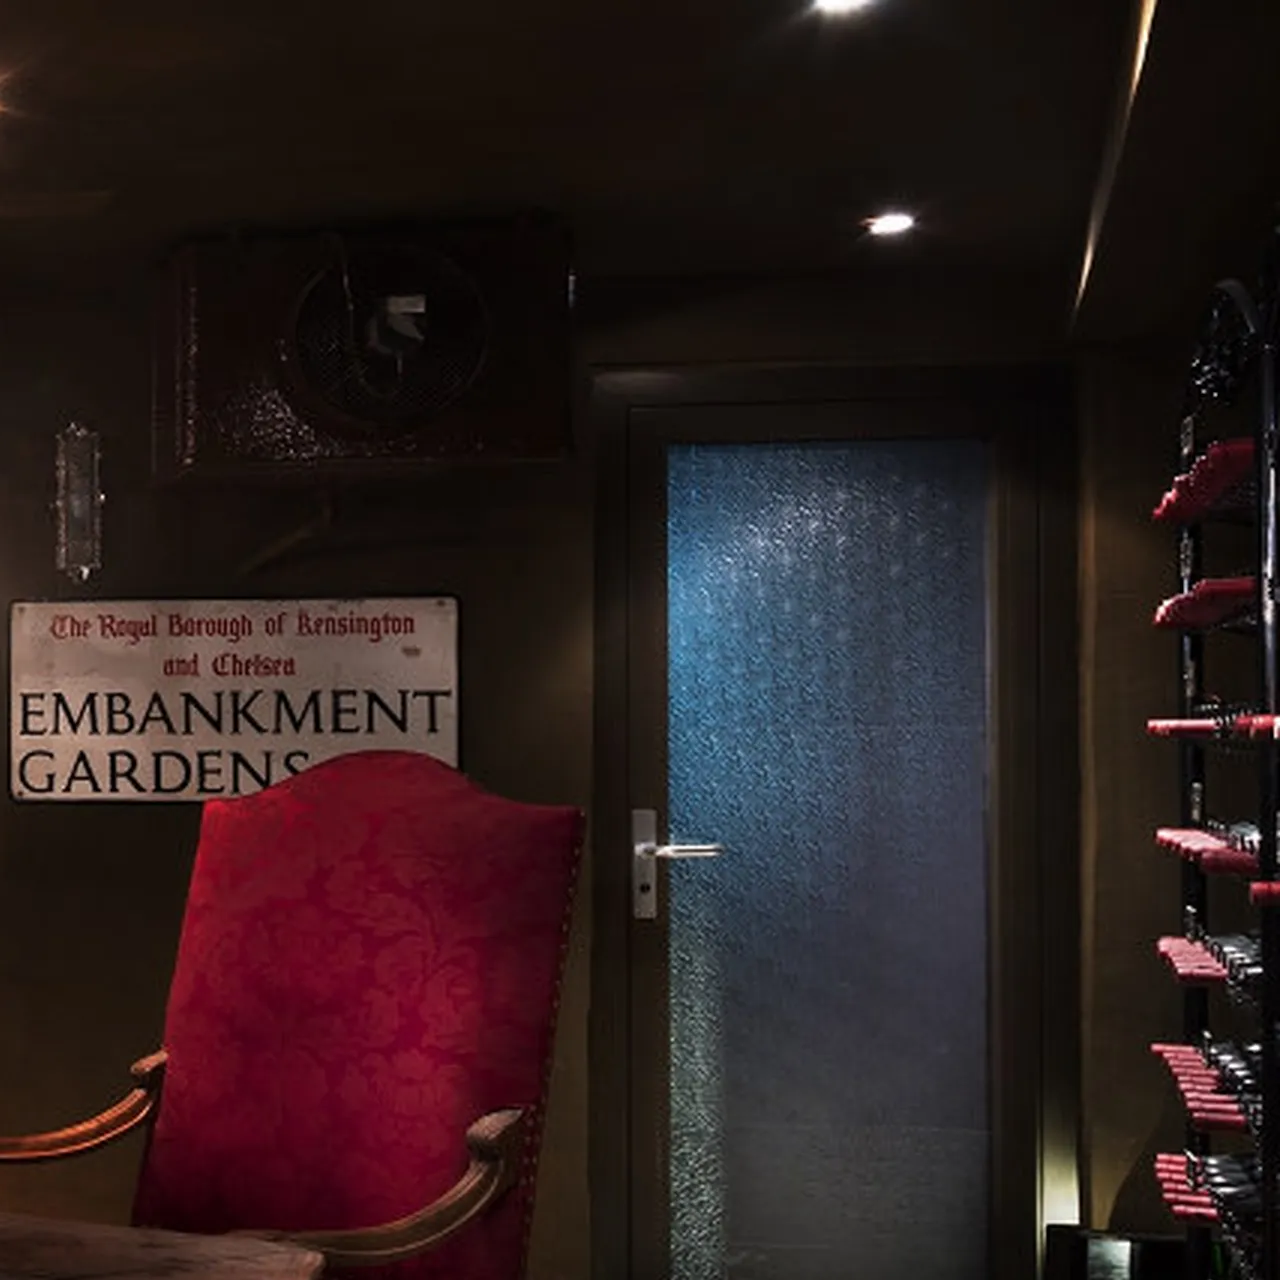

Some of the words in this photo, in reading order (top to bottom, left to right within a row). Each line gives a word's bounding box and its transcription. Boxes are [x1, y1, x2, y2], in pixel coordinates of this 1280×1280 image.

[50, 614, 91, 639] The
[98, 614, 158, 645] Royal
[168, 614, 253, 643] Borough
[264, 612, 287, 637] of
[297, 611, 415, 643] Kensington
[163, 653, 200, 676] and
[212, 653, 297, 677] Chelsea
[19, 689, 451, 736] EMBANKMENT
